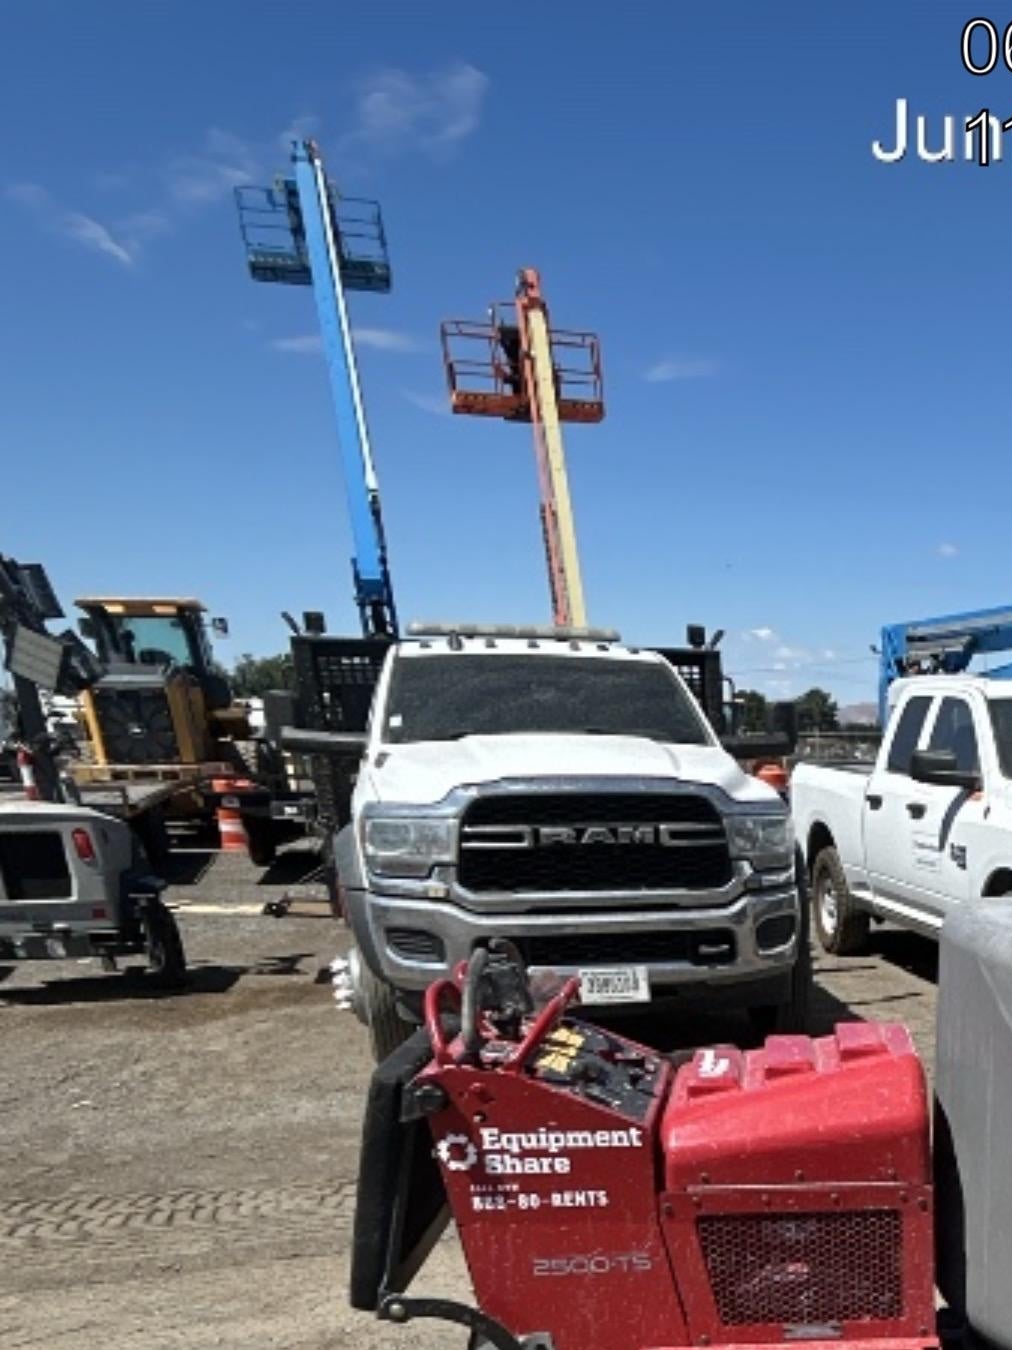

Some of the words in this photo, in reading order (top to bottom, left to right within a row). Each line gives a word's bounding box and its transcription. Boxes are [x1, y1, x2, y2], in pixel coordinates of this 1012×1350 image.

[539, 826, 655, 845] RAM
[480, 1127, 643, 1152] Equipment
[485, 1154, 571, 1174] Share
